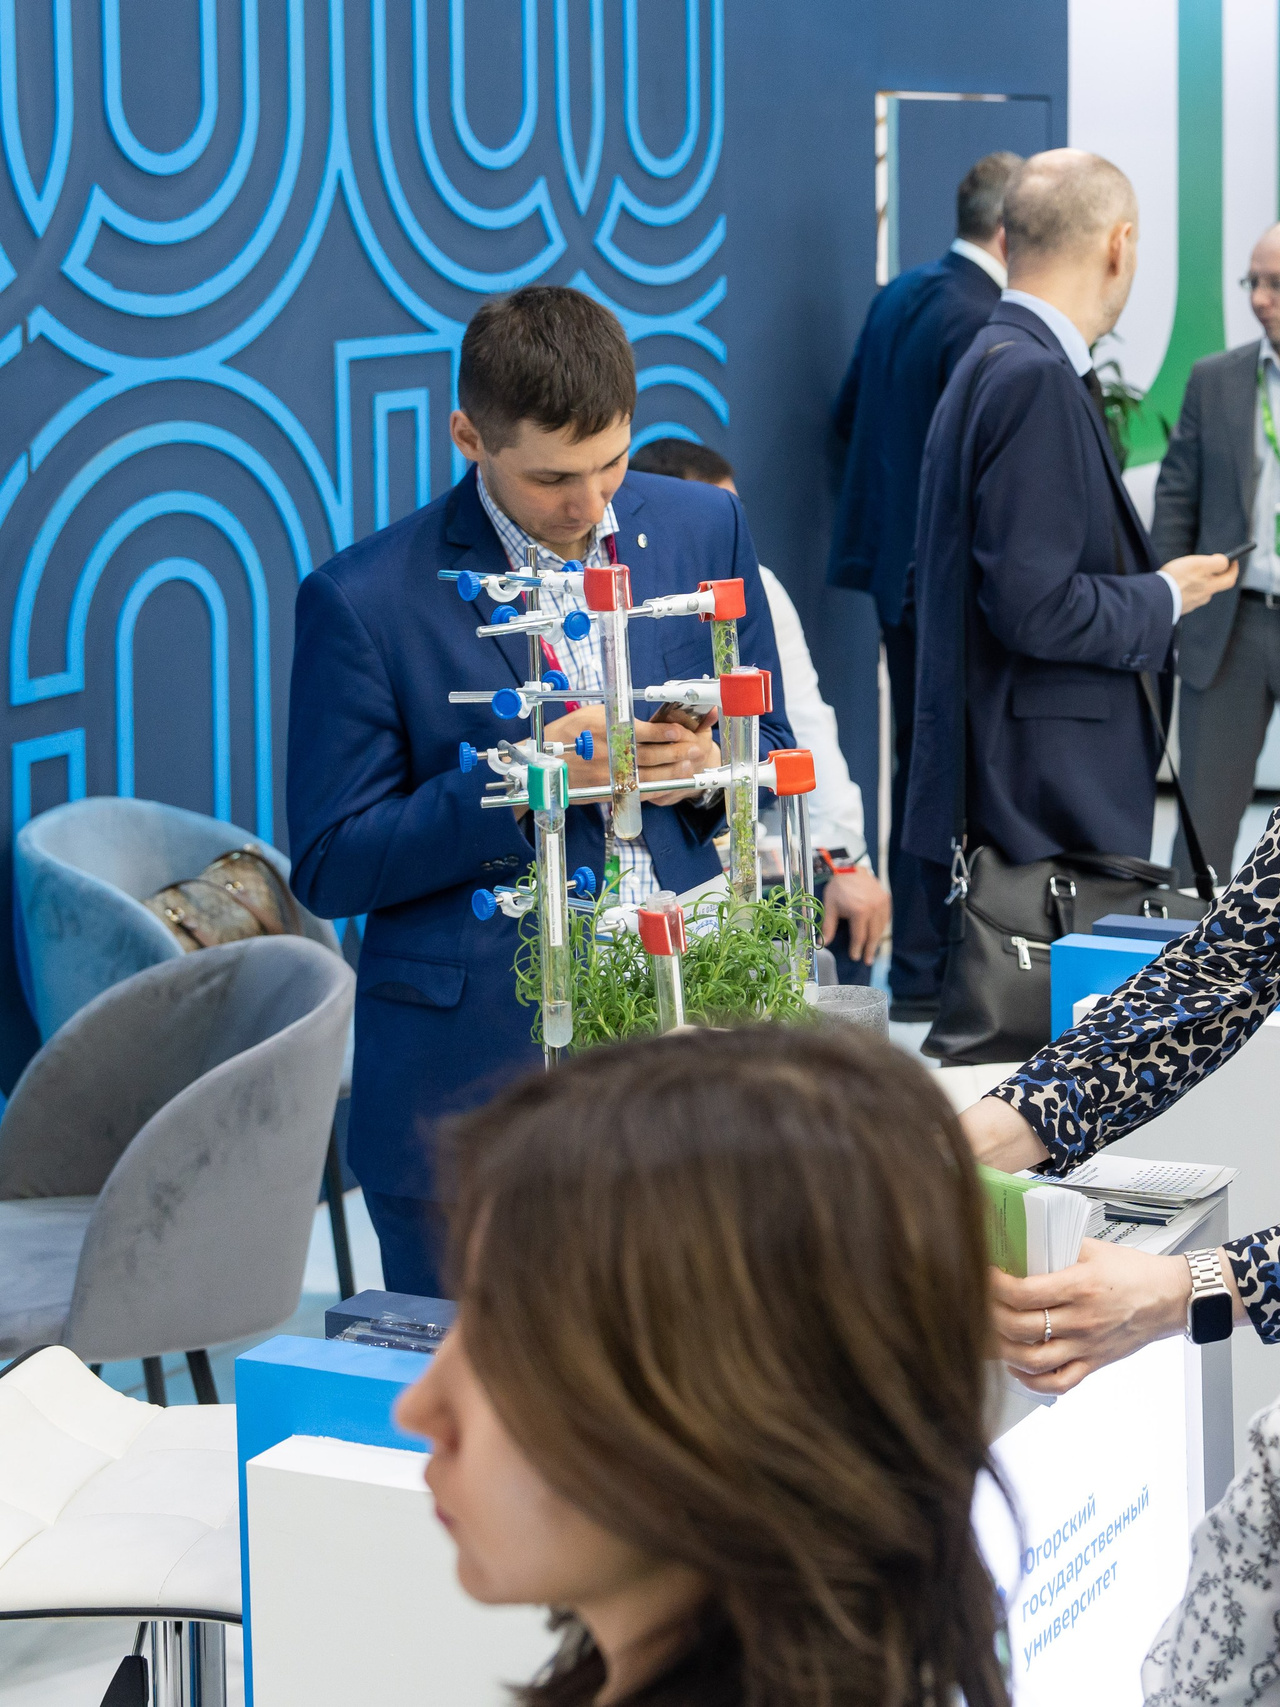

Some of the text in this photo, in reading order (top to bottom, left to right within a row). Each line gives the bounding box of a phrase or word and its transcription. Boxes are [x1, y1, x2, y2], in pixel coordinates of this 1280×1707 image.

[1020, 1492, 1096, 1578] Югорский
[1022, 1484, 1150, 1622] государственный
[1023, 1560, 1118, 1672] университет
